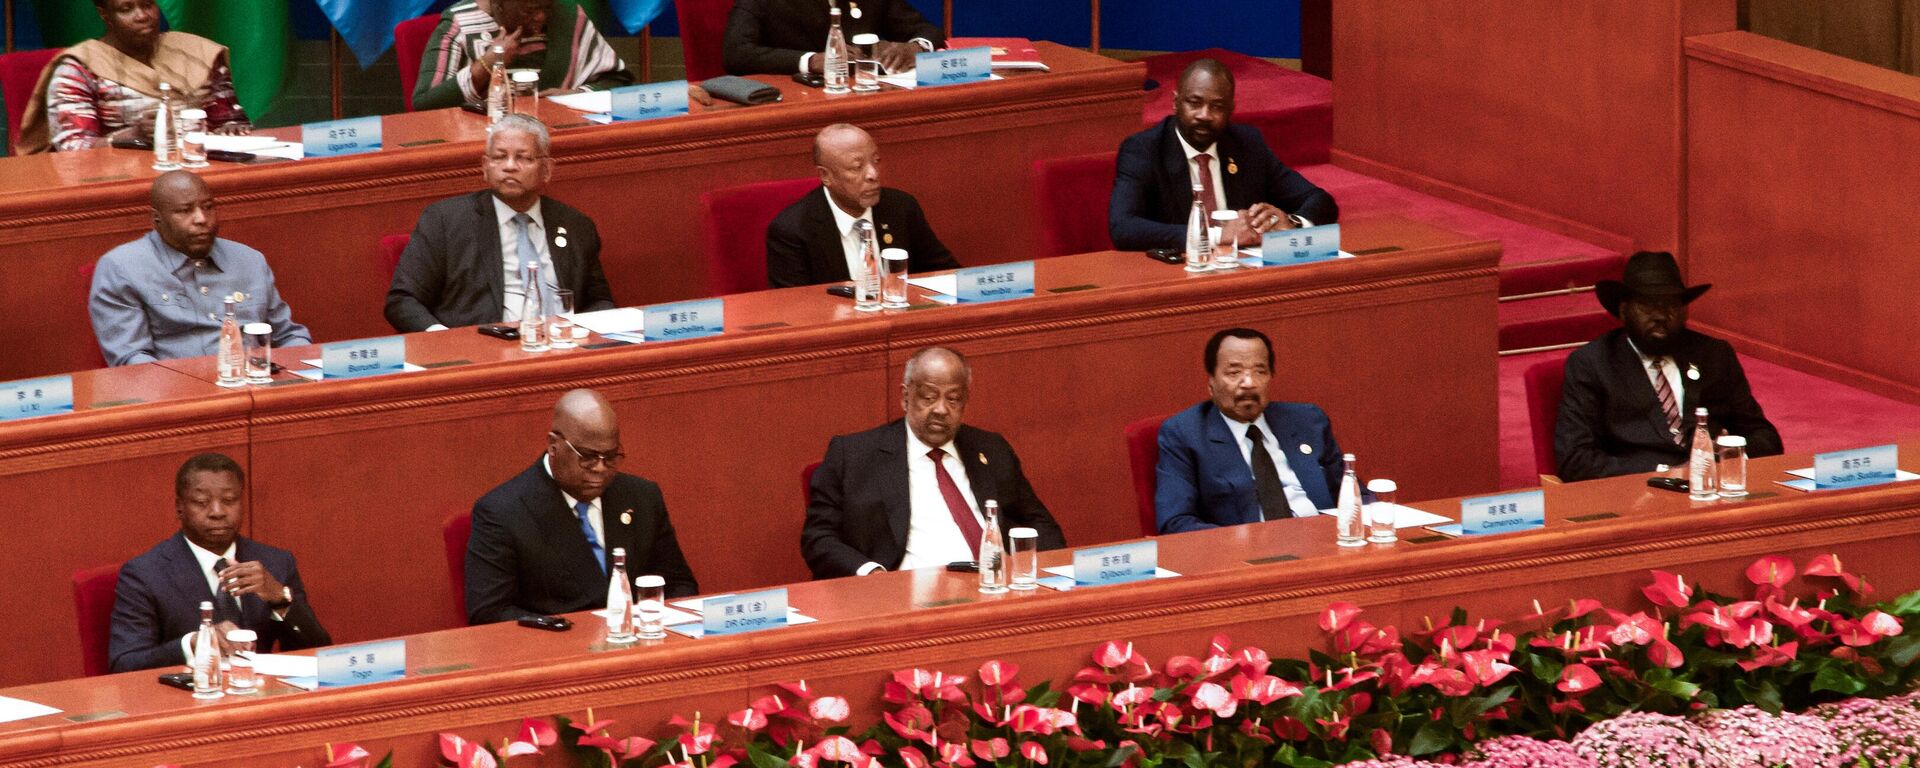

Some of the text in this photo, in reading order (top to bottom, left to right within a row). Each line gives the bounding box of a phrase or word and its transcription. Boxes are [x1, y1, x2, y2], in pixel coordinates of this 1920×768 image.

[941, 58, 967, 69] 安哥拉
[941, 71, 967, 82] Angola
[639, 106, 661, 115] Benin
[328, 128, 357, 139] 乌干达
[328, 142, 358, 152] Uganda
[1293, 249, 1309, 258] Mali
[977, 272, 1014, 285] 纳米比亚
[981, 287, 1011, 296] Namibia
[670, 311, 697, 323] 塞舌尔
[663, 325, 706, 337] Seychelles
[349, 349, 378, 360] 布隆迪
[348, 361, 380, 373] Burundi
[1842, 457, 1871, 469] 南苏丹
[1831, 470, 1882, 484] South Sudan
[1488, 503, 1518, 515] 喀麦隆
[1482, 517, 1524, 529] Cameroon
[1102, 553, 1131, 567] 吉布提
[1100, 568, 1132, 580] Djibouti
[725, 616, 767, 629] DR Congo
[348, 654, 375, 667] 多哥
[351, 670, 372, 680] Togo
